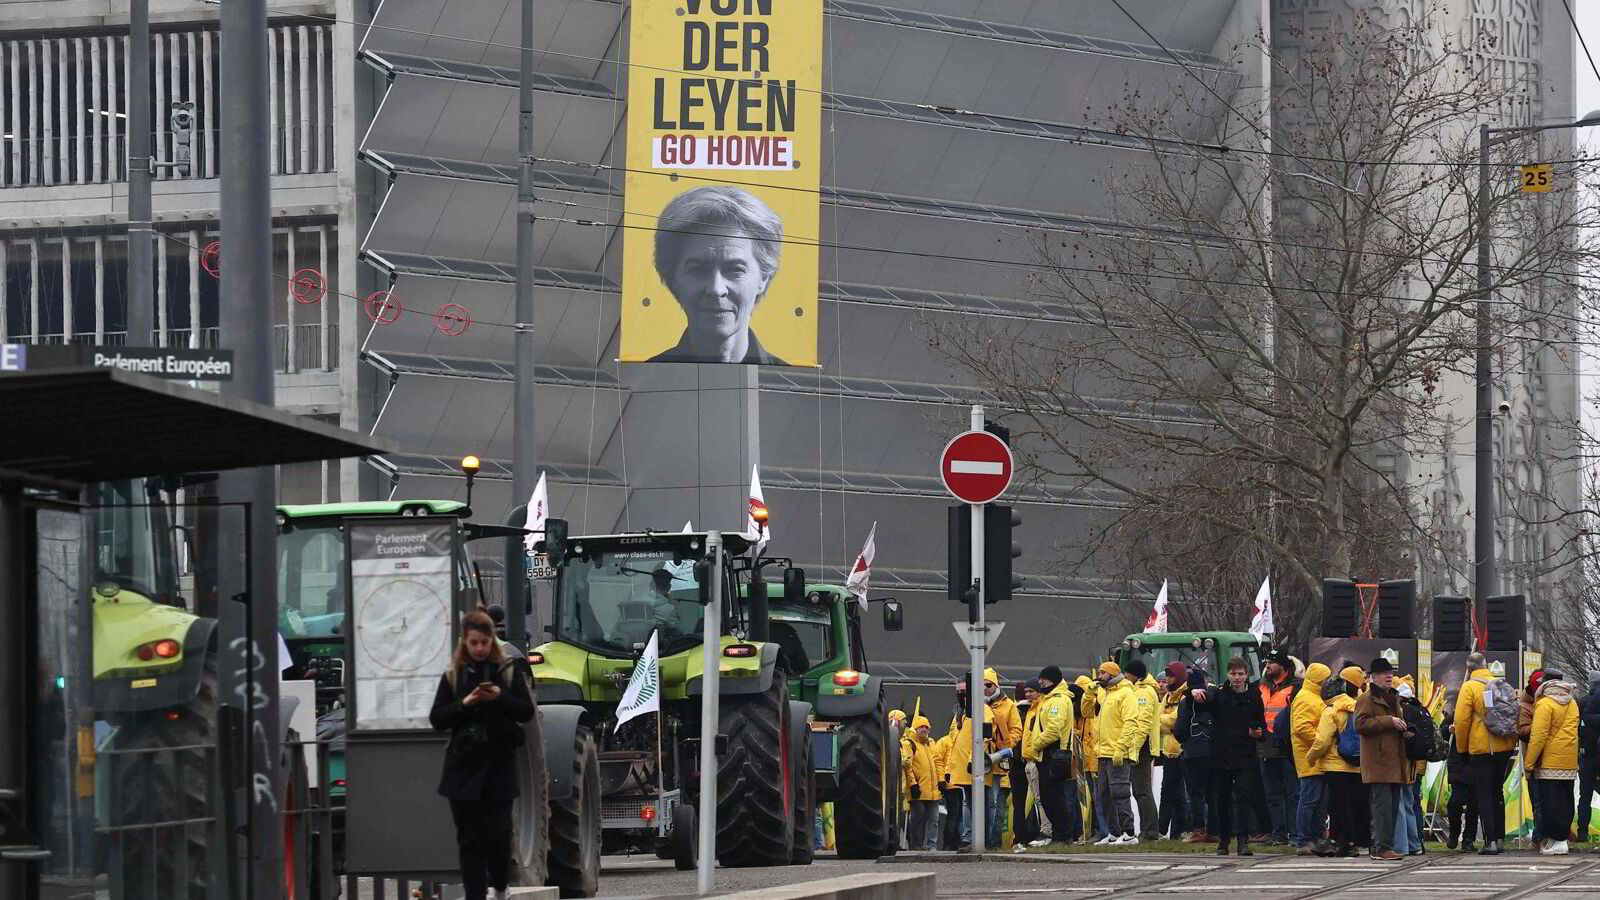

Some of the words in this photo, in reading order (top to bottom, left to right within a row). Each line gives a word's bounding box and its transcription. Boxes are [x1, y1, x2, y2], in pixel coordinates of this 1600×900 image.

[683, 21, 770, 72] DER
[653, 78, 796, 132] LEYEN
[660, 134, 697, 165] GO
[707, 135, 788, 167] HOME
[1524, 171, 1548, 188] 25
[93, 352, 164, 373] Parlement
[166, 355, 231, 378] Européen
[375, 533, 427, 544] Parlement
[620, 537, 652, 545] CLAAS
[376, 544, 426, 556] Européen
